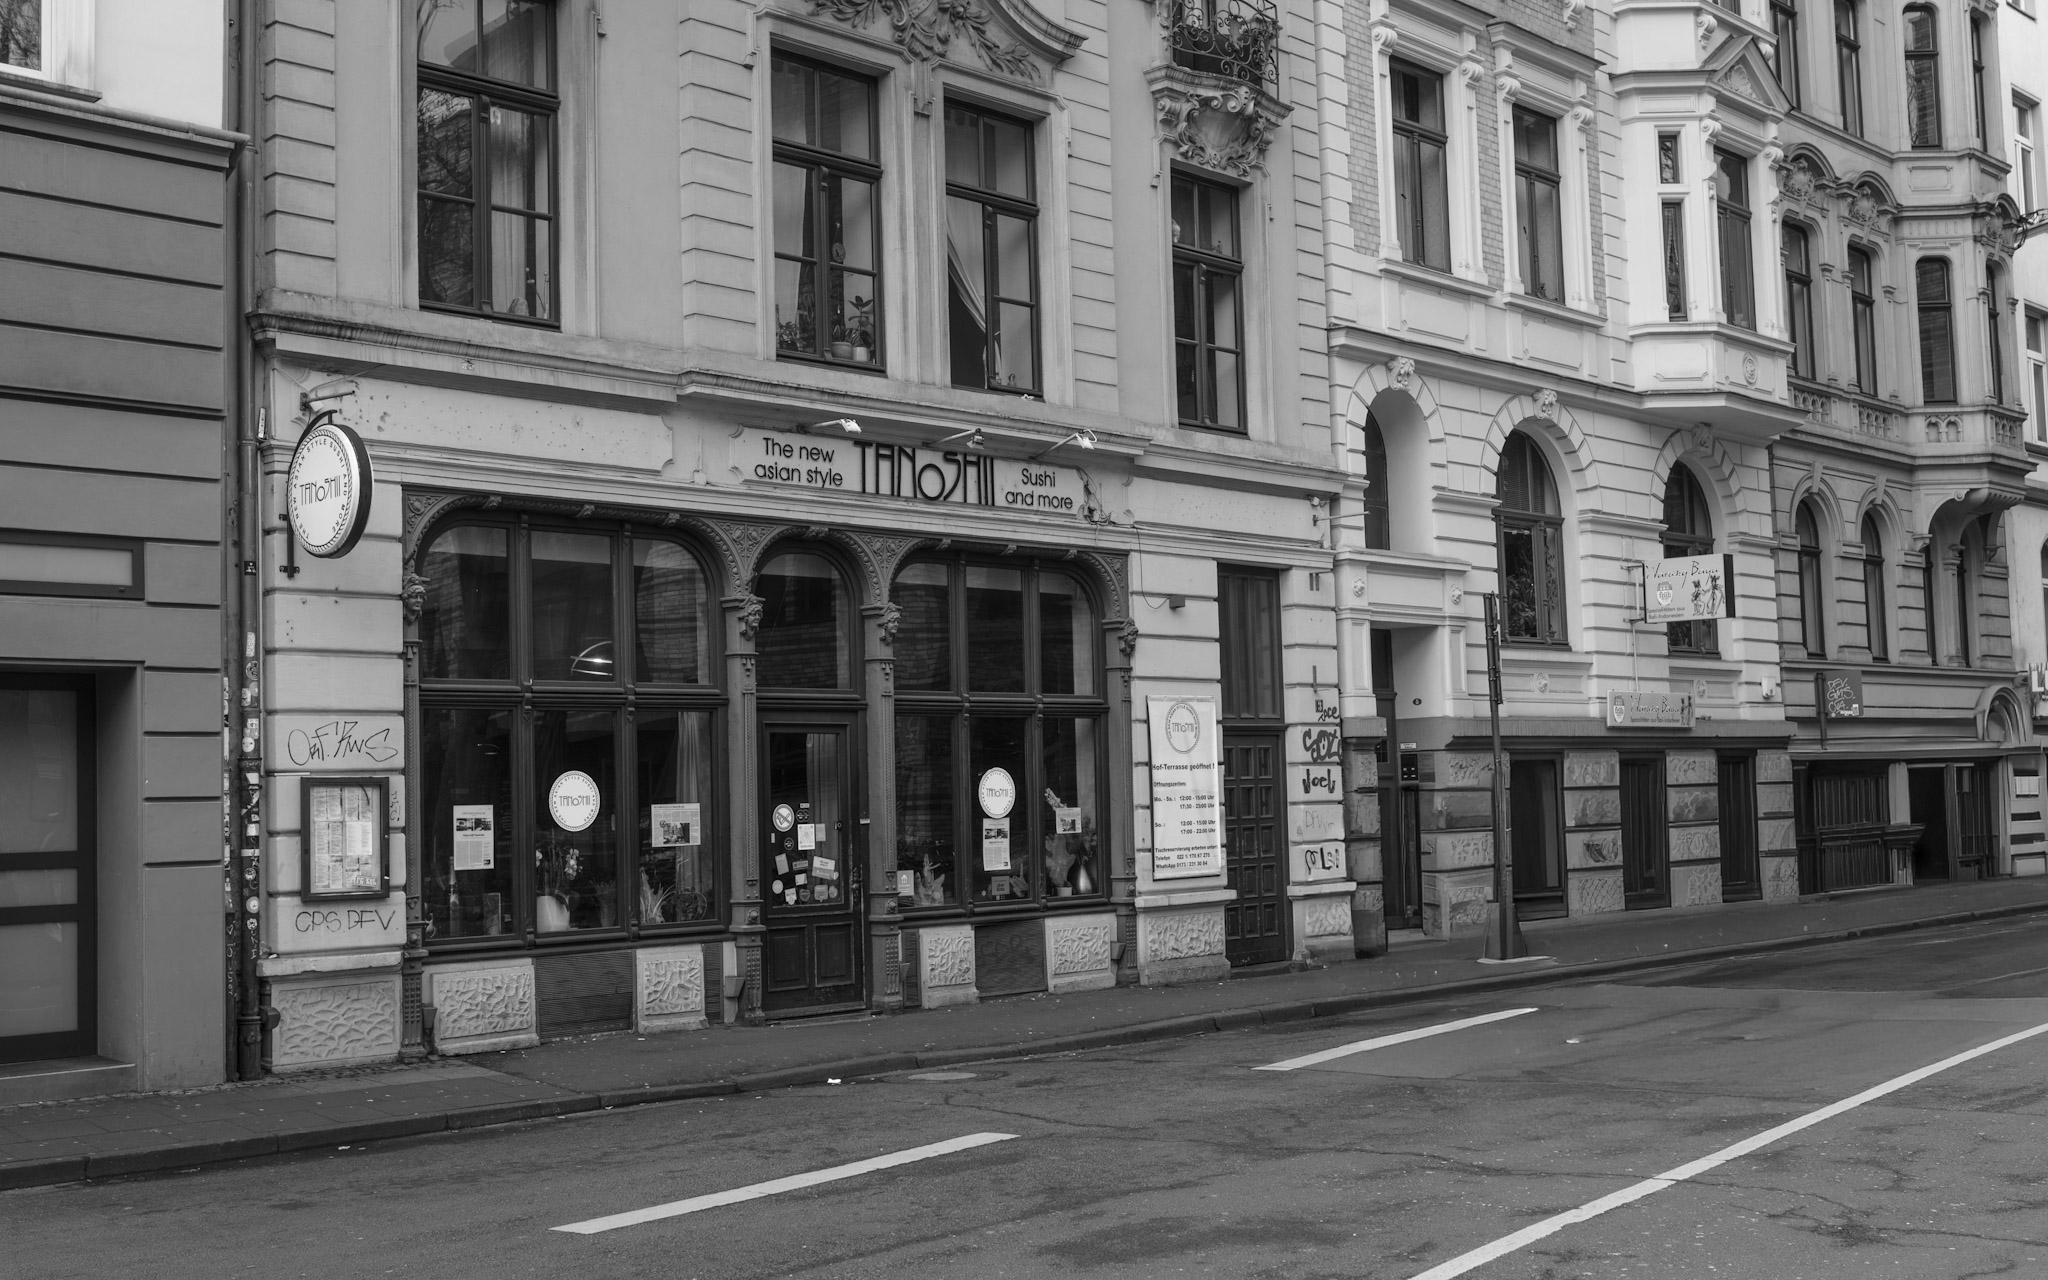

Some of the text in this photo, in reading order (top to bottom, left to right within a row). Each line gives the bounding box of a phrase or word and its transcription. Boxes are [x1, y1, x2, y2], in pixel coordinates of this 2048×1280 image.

[306, 438, 328, 453] STYLE
[329, 441, 345, 468] SUSHI
[763, 437, 835, 464] The new
[292, 456, 306, 489] ASIAN
[754, 462, 843, 489] asian style
[1021, 468, 1056, 488] Sushi
[1005, 490, 1073, 510] and more
[331, 503, 346, 533] MORE
[1152, 763, 1188, 771] Hof-Terrasse
[1189, 763, 1212, 772] geöffnet
